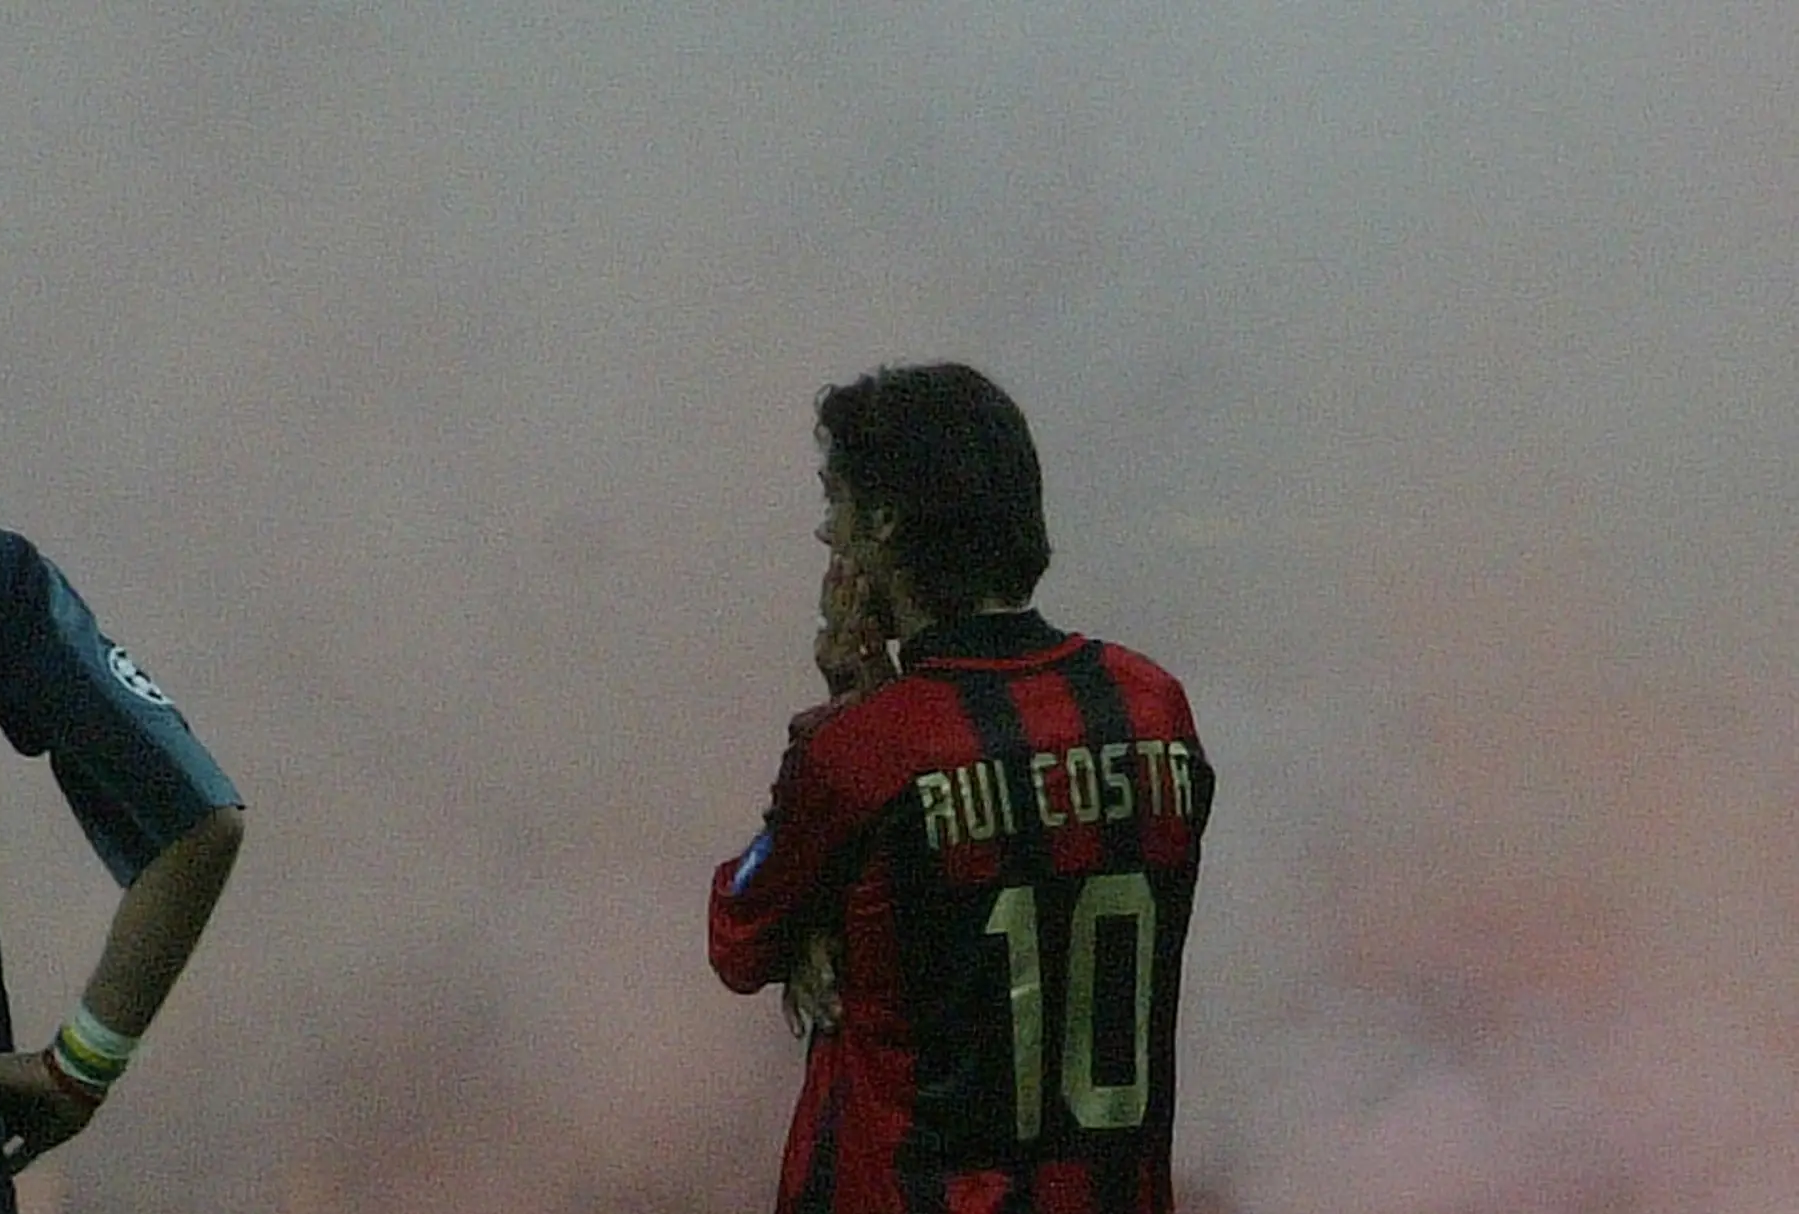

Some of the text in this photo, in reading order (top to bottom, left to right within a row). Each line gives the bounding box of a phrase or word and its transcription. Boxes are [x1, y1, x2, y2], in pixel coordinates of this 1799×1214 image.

[915, 738, 1194, 851] RUI COSTA
[984, 872, 1157, 1141] 10
